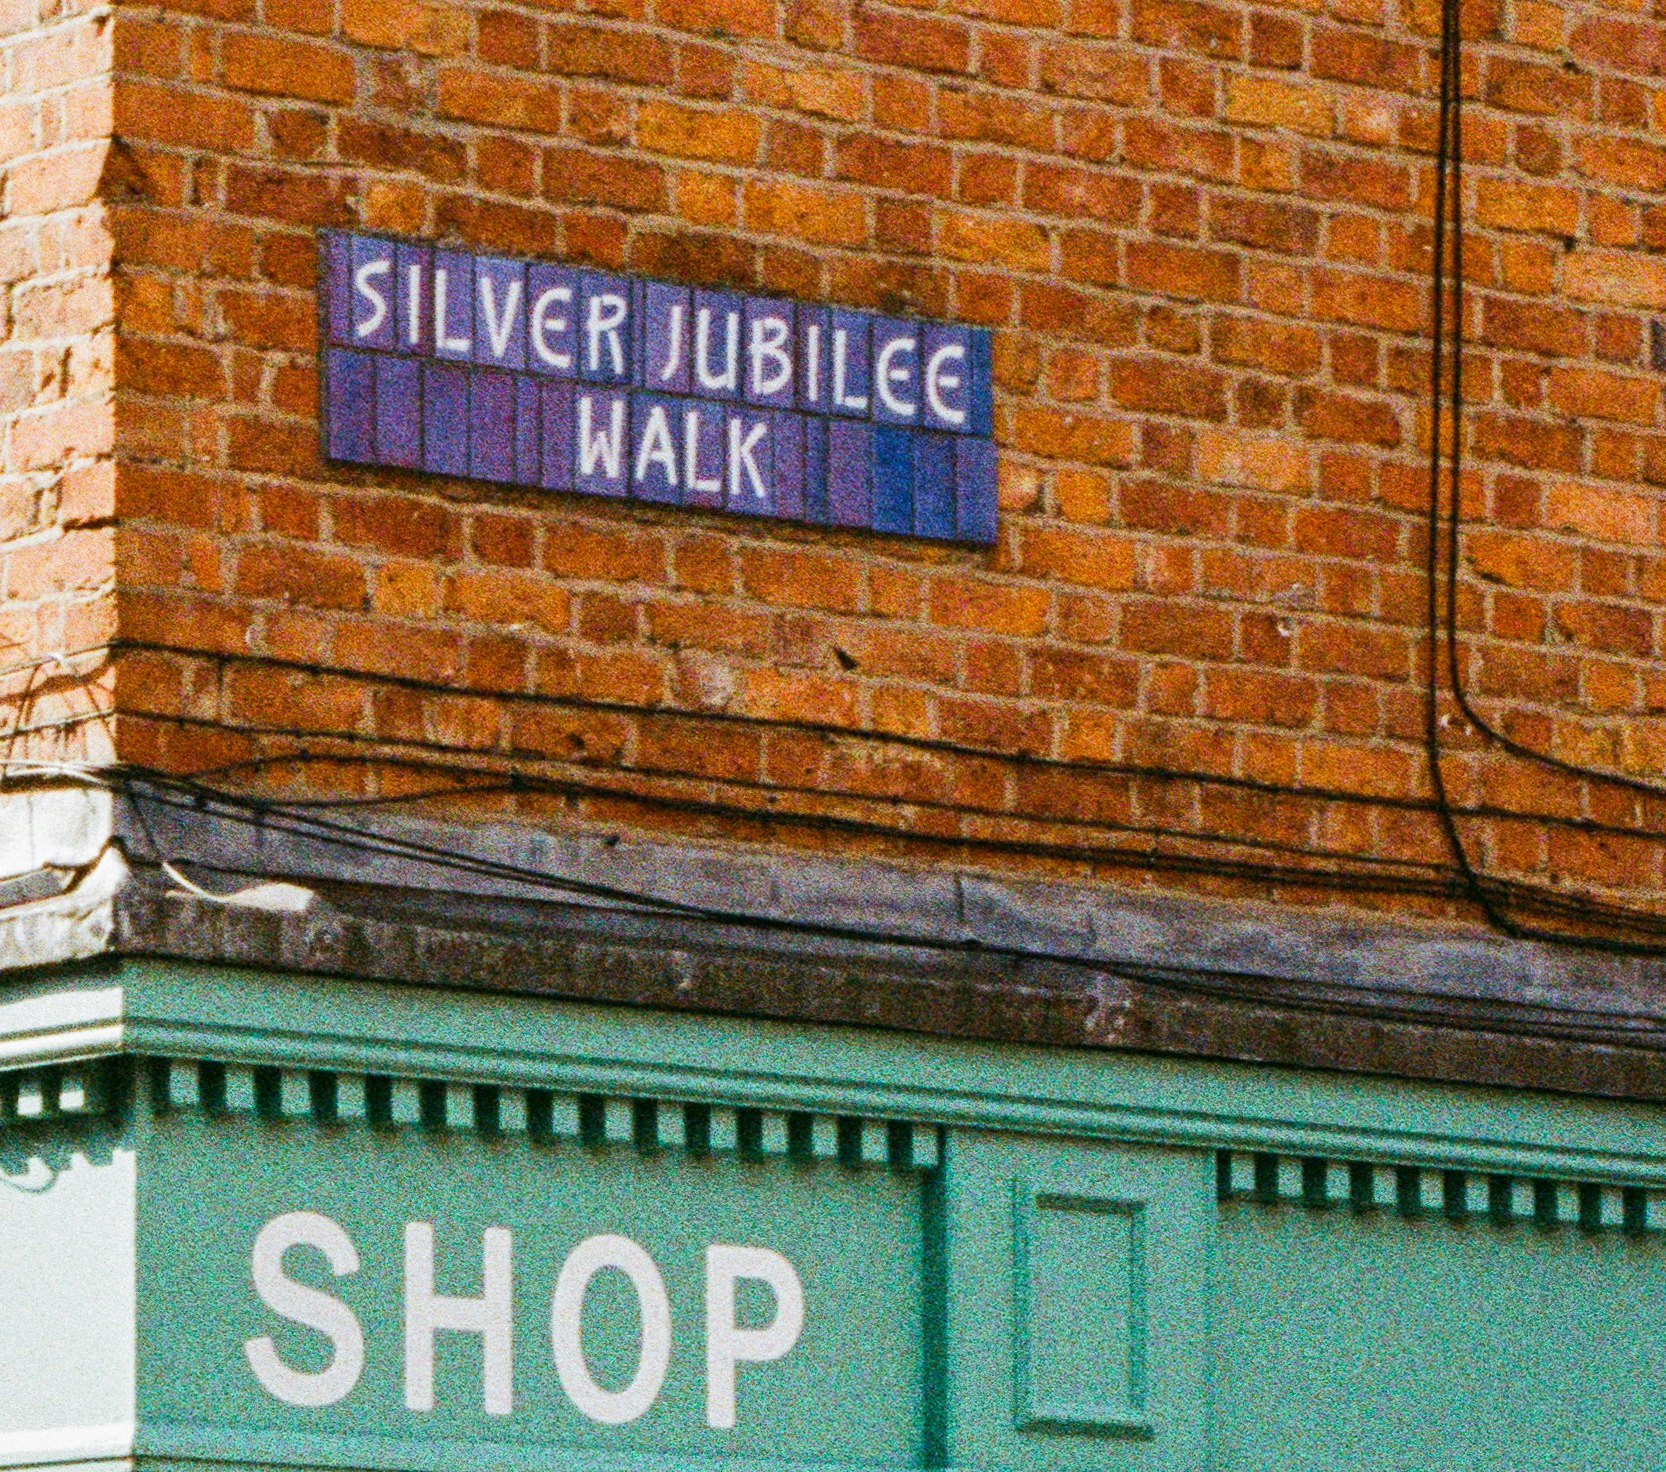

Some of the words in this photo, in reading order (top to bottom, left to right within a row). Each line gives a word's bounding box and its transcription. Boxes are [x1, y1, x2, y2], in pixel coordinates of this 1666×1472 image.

[352, 258, 626, 376] SILVER
[660, 304, 968, 424] JUBILEE
[577, 397, 768, 499] WALK
[244, 1210, 805, 1430] SHOP
